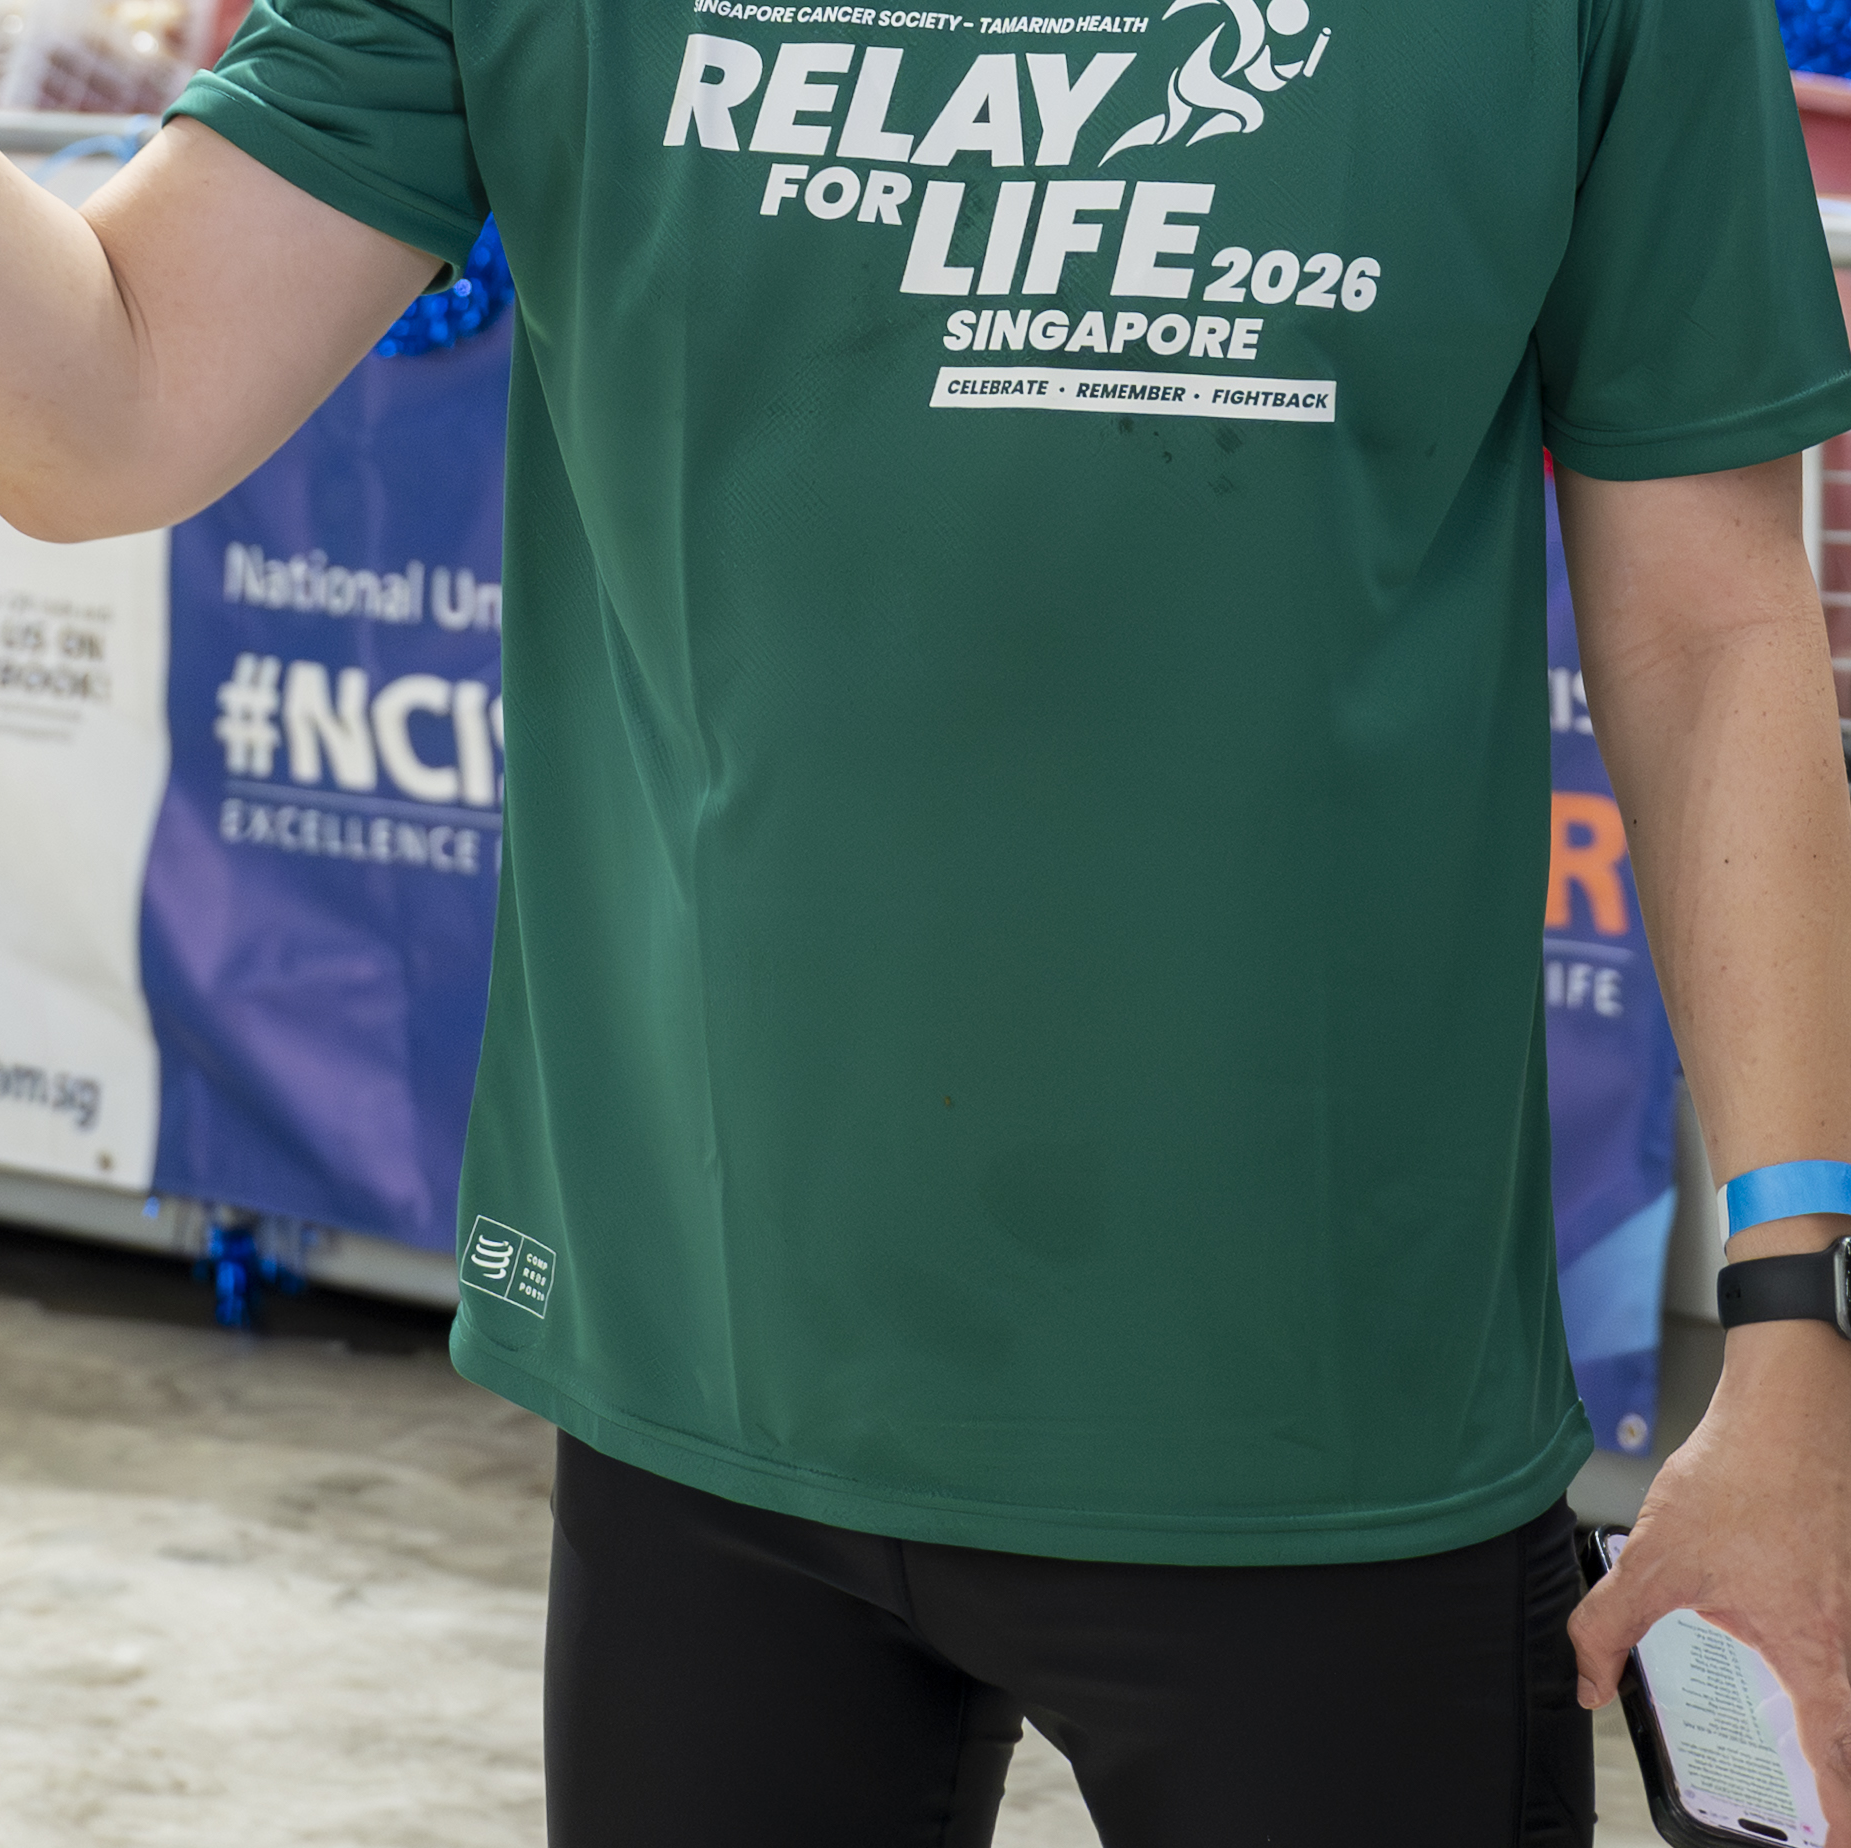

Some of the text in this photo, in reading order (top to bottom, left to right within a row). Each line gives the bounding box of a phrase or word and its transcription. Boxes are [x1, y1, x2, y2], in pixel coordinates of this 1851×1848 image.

[796, 5, 876, 26] CANCER
[877, 10, 963, 32] SOCIETY
[979, 16, 1075, 34] TAMARIND
[1075, 15, 1149, 33] HEALTH
[663, 33, 1137, 168] RELAY
[760, 164, 1381, 312] FOR LIFE 2026
[942, 309, 1264, 360] SINGAPORE
[947, 379, 1329, 409] CELEBRATE REMEMBER FIGHTBACK
[224, 541, 502, 632] National Un
[214, 651, 503, 807] #NCI
[220, 798, 479, 875] EXCELLENCE
